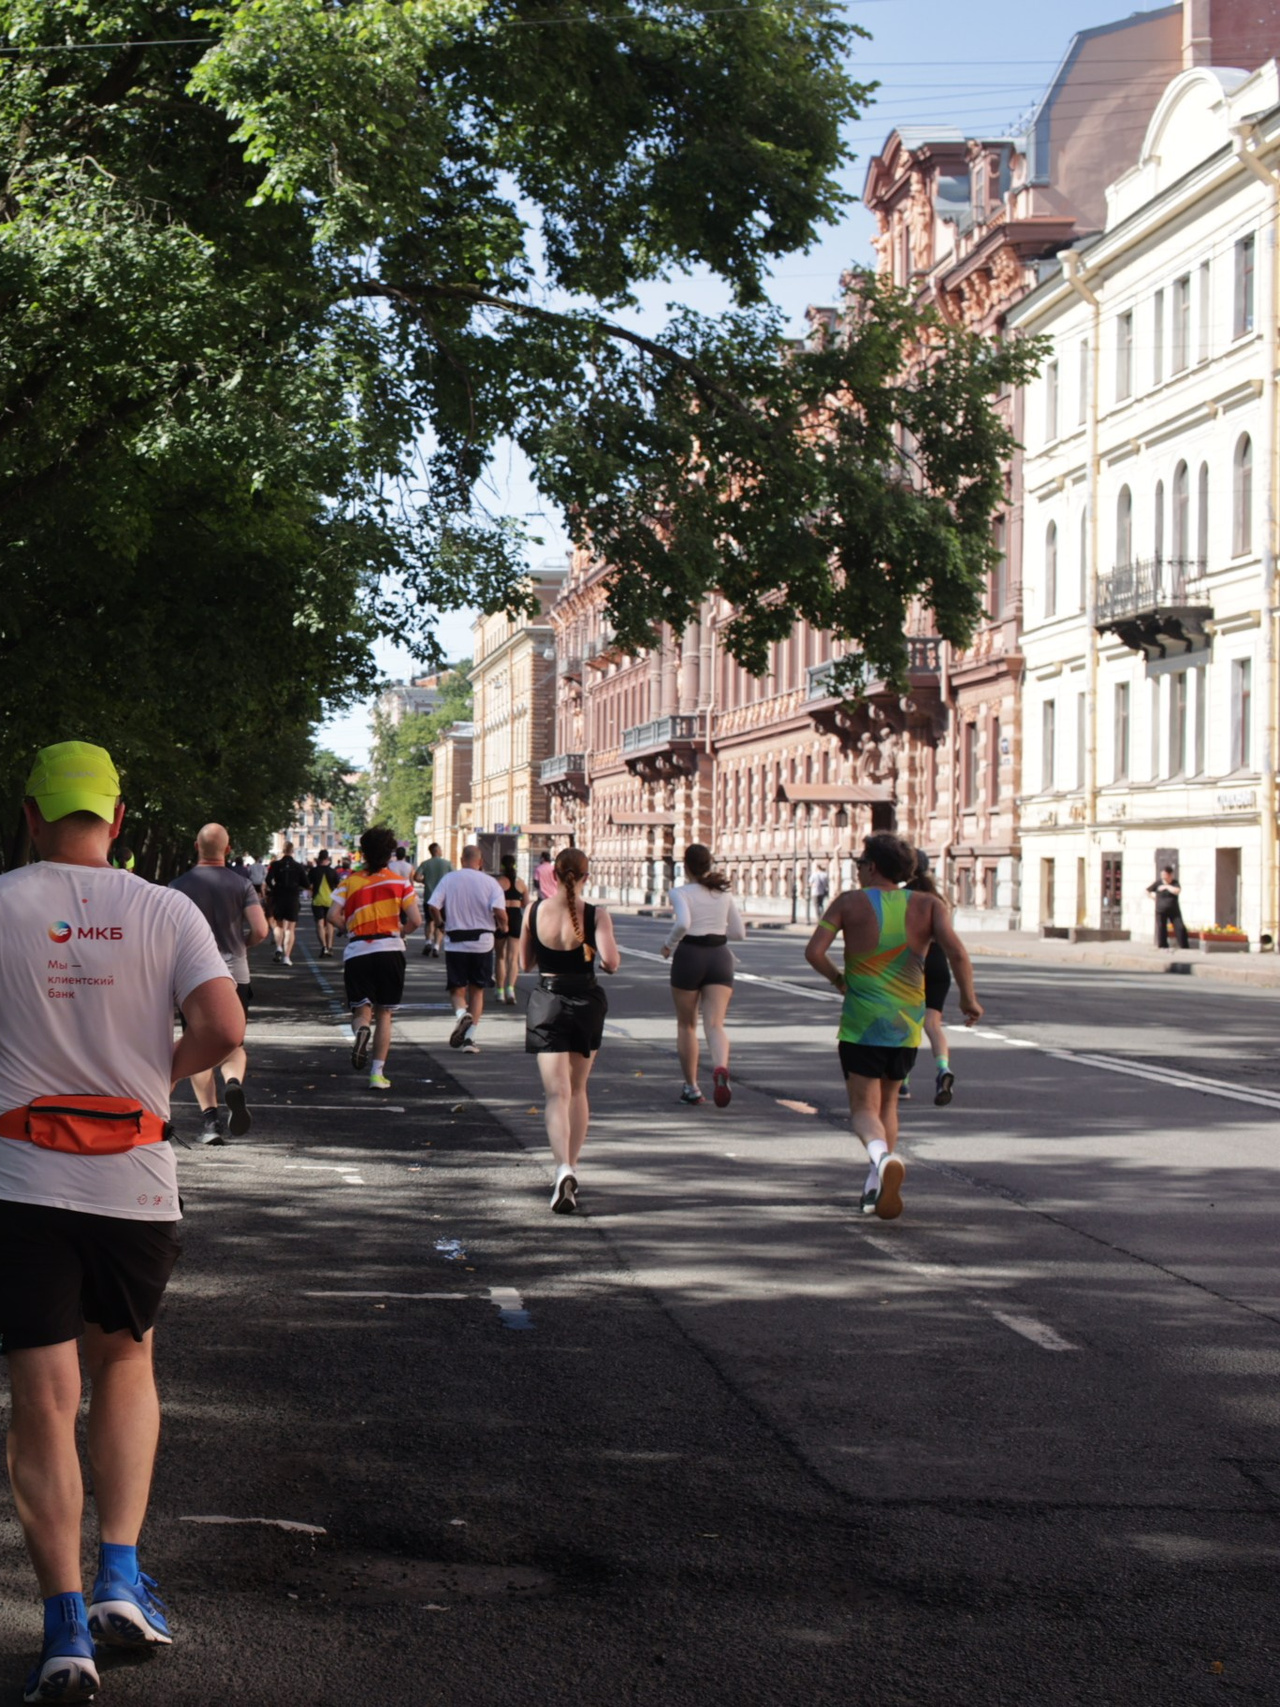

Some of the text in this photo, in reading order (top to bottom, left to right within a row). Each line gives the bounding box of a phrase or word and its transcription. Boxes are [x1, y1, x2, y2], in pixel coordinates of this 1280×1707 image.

[77, 927, 123, 940] МКБ
[48, 960, 68, 970] Мы
[48, 975, 114, 986] клиентский
[48, 988, 75, 999] банк
